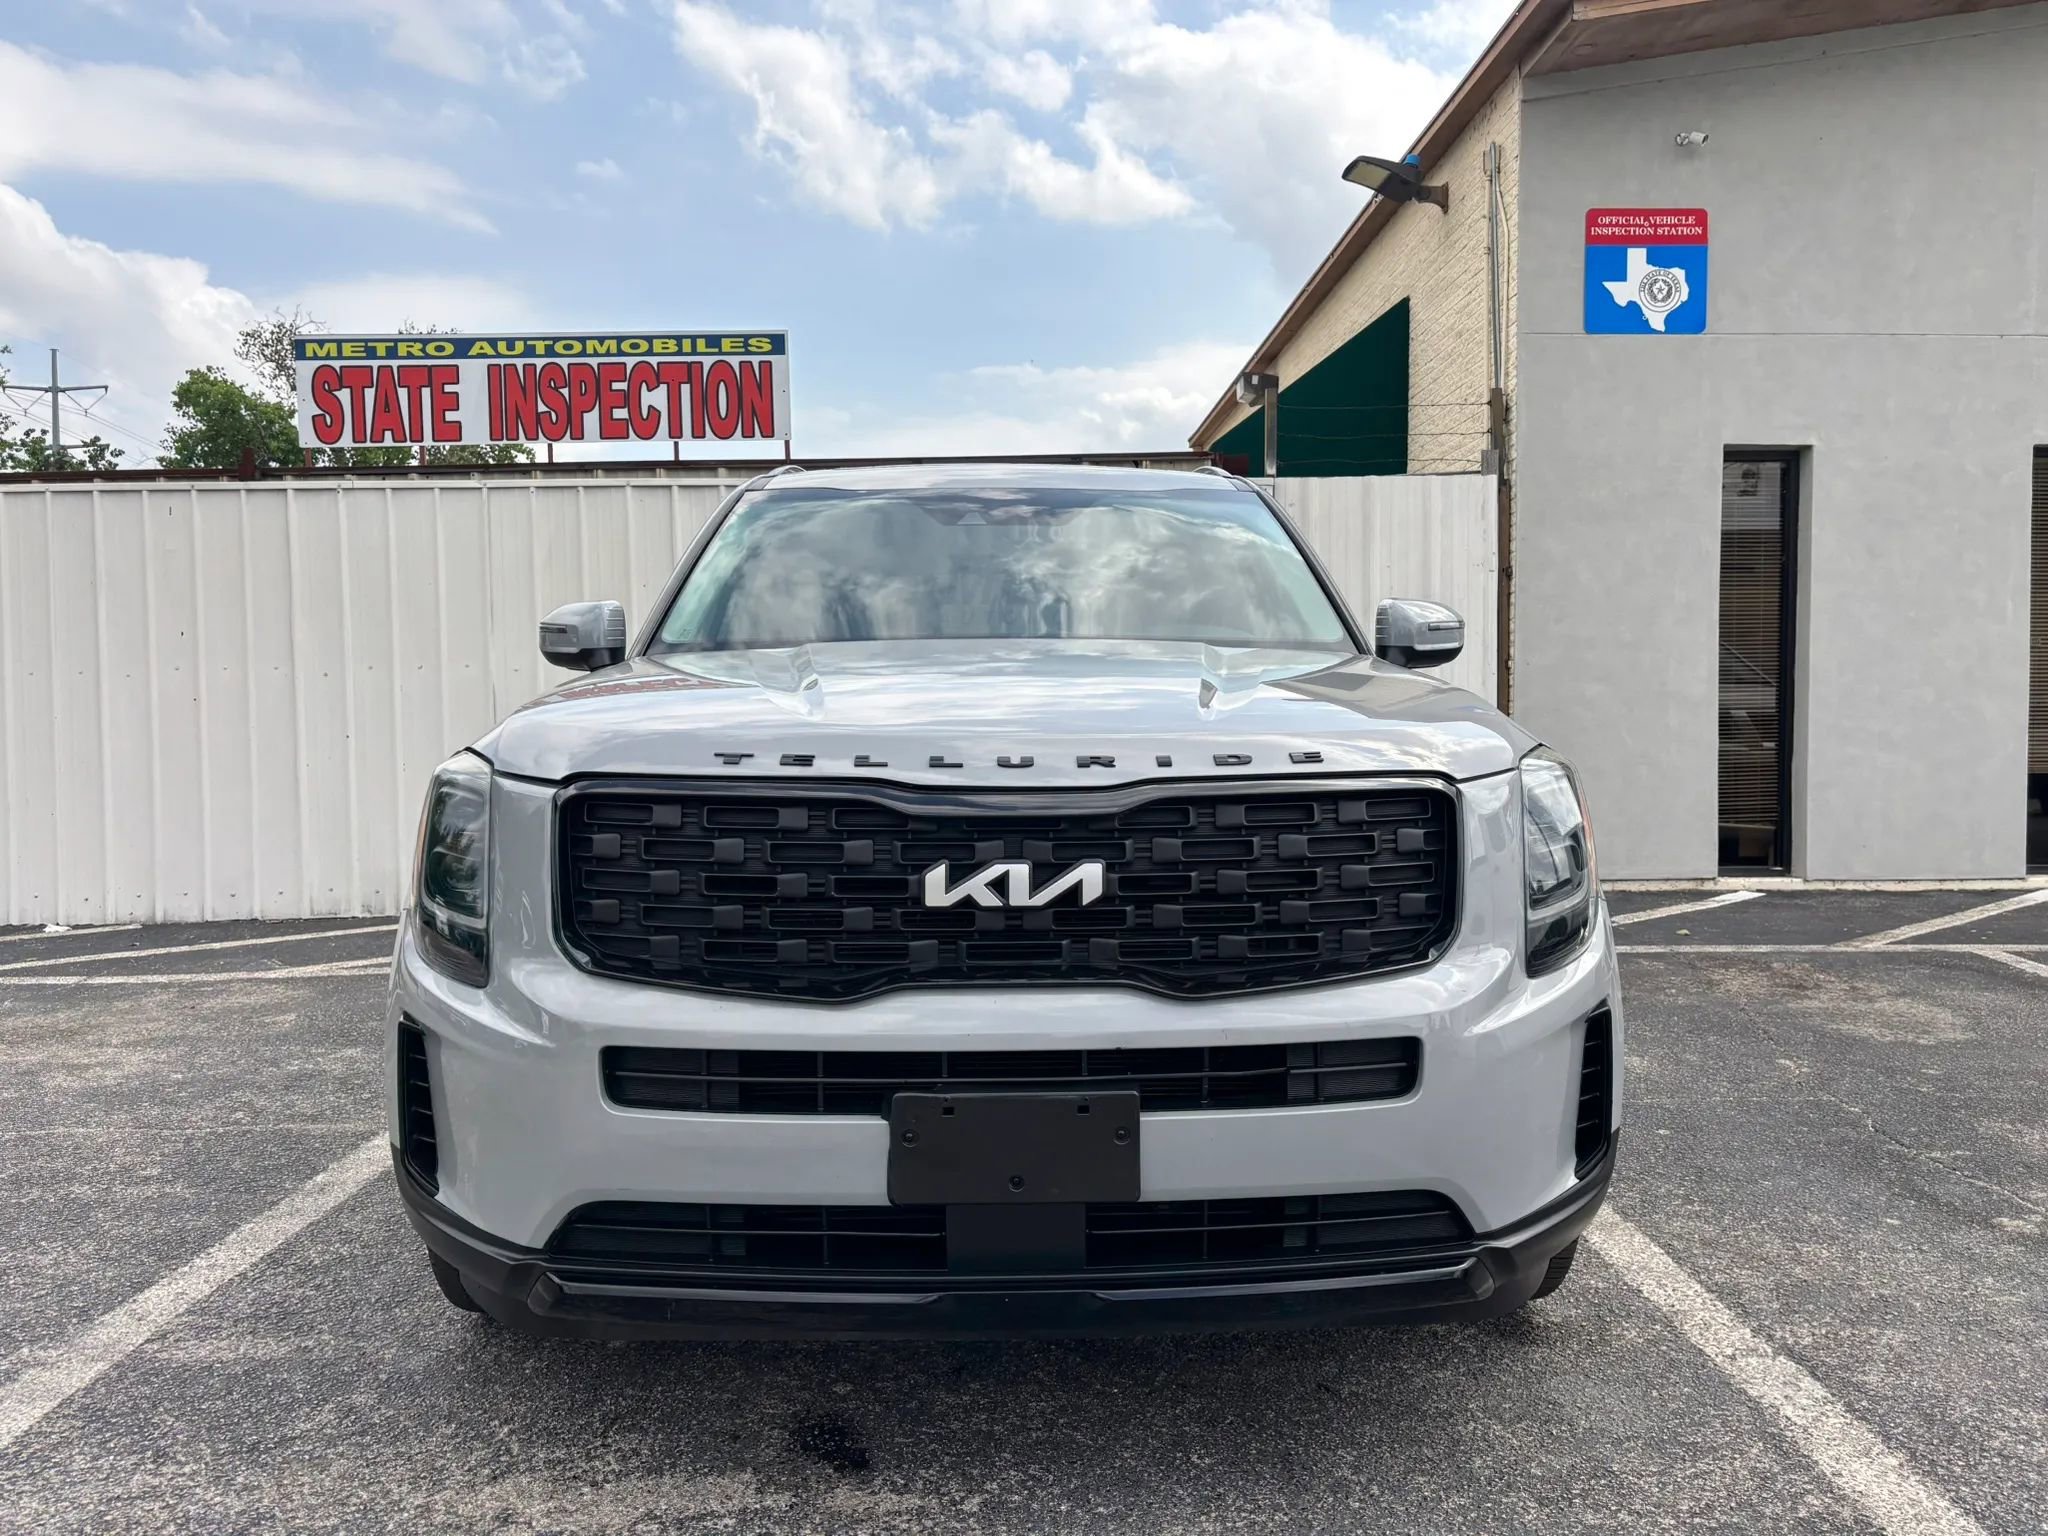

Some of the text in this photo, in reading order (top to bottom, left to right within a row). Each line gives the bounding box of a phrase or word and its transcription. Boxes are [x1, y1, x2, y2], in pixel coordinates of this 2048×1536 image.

[1597, 215, 1696, 225] OFFICIAL VEHICLE
[1590, 226, 1703, 236] INSPECTION STATION
[305, 337, 773, 358] METRO AUTOMOBILES
[311, 360, 775, 445] STATE INSPECTION
[713, 750, 1325, 769] TELLURIDE
